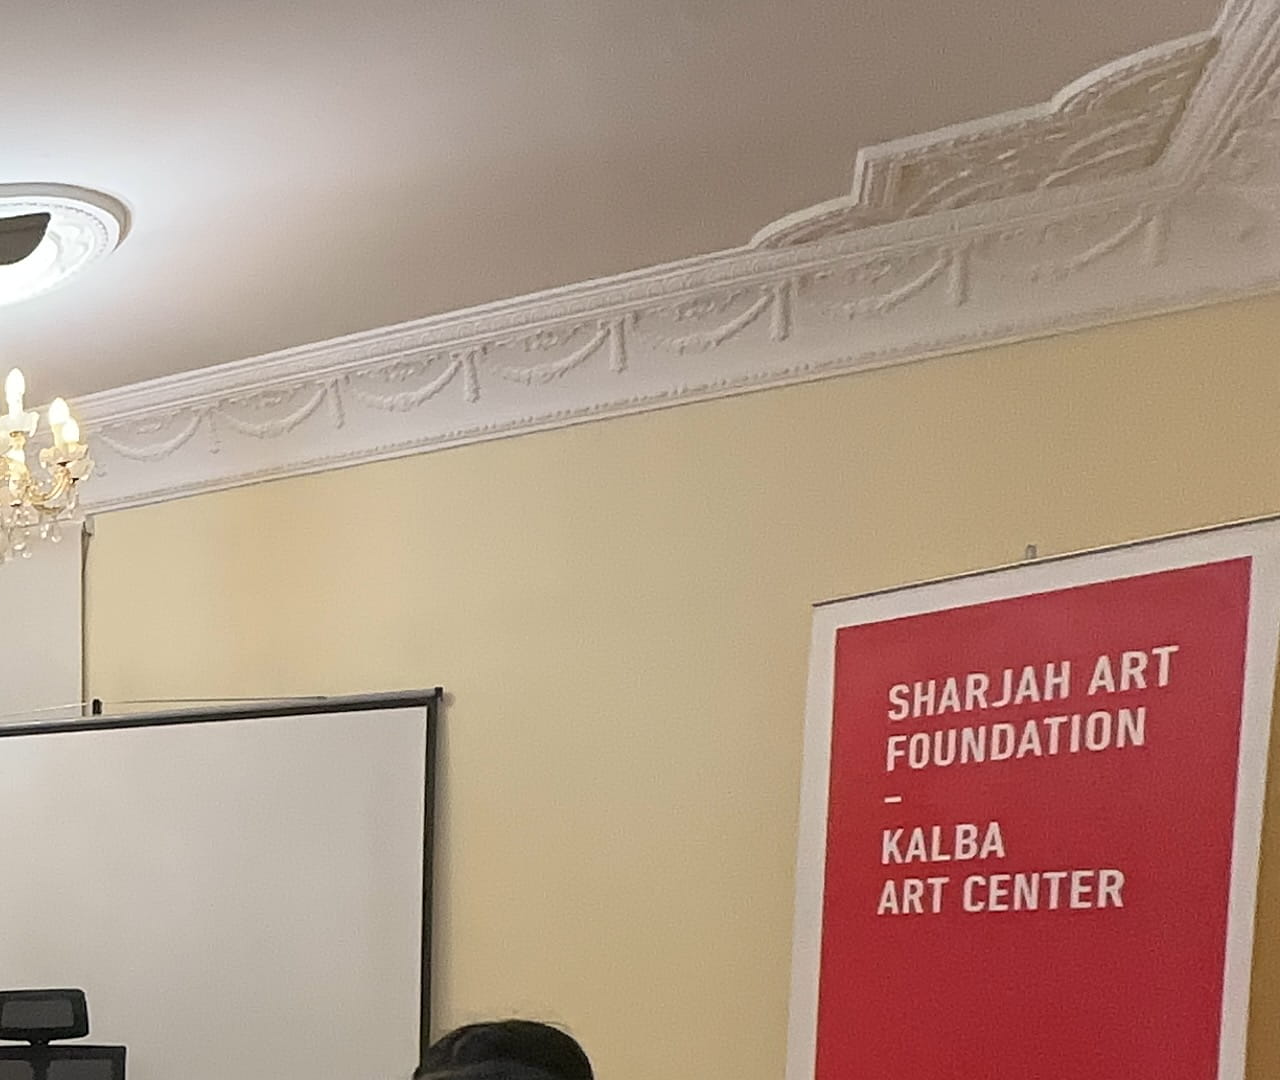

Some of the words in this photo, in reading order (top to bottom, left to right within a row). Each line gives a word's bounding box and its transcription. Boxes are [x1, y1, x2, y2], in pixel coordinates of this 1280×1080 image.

[886, 659, 1072, 722] SHARJAH
[1086, 644, 1181, 697] ART
[885, 705, 1148, 773] FOUNDATION
[880, 820, 1007, 866] KALBA
[876, 875, 951, 916] ART
[962, 868, 1126, 914] CENTER
